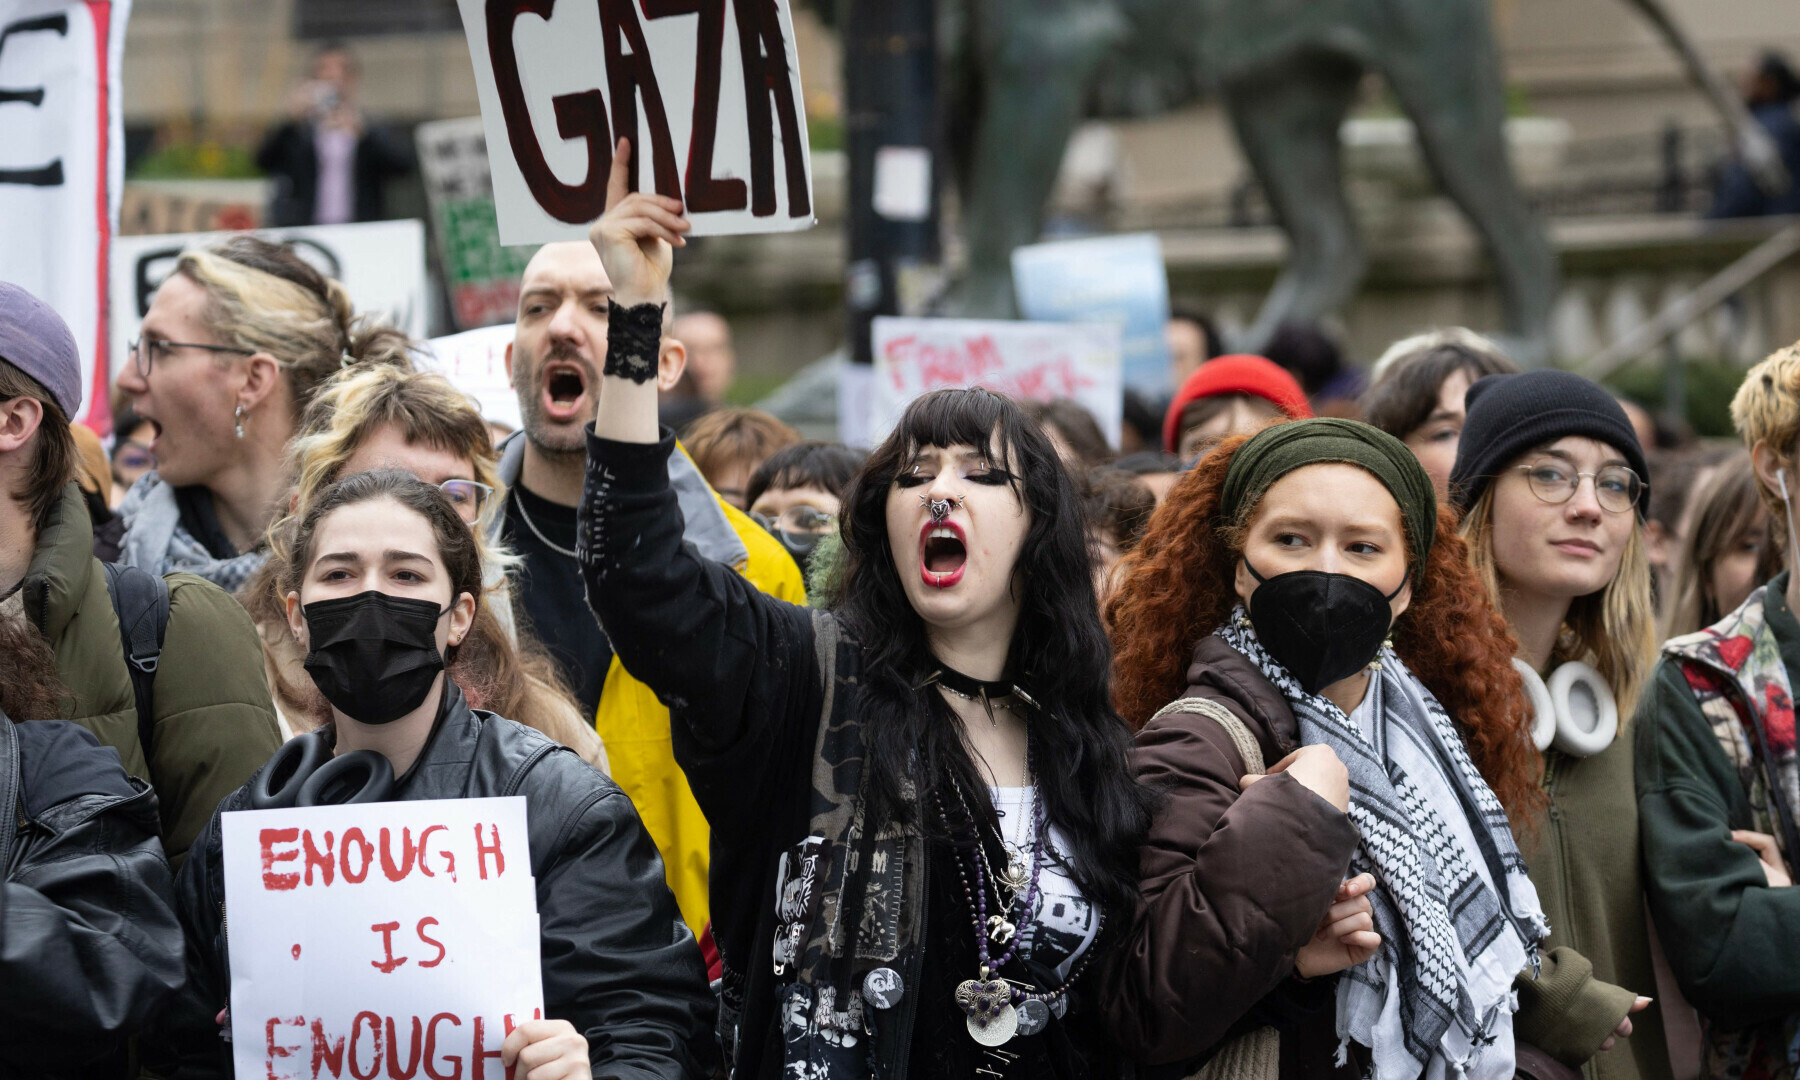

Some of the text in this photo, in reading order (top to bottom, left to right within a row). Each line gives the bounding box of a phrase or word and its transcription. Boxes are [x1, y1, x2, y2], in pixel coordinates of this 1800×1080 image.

[485, 0, 811, 225] GAZA
[259, 822, 506, 891] ENOUGH
[371, 916, 446, 973] IS
[265, 1007, 541, 1080] ENOUGH
